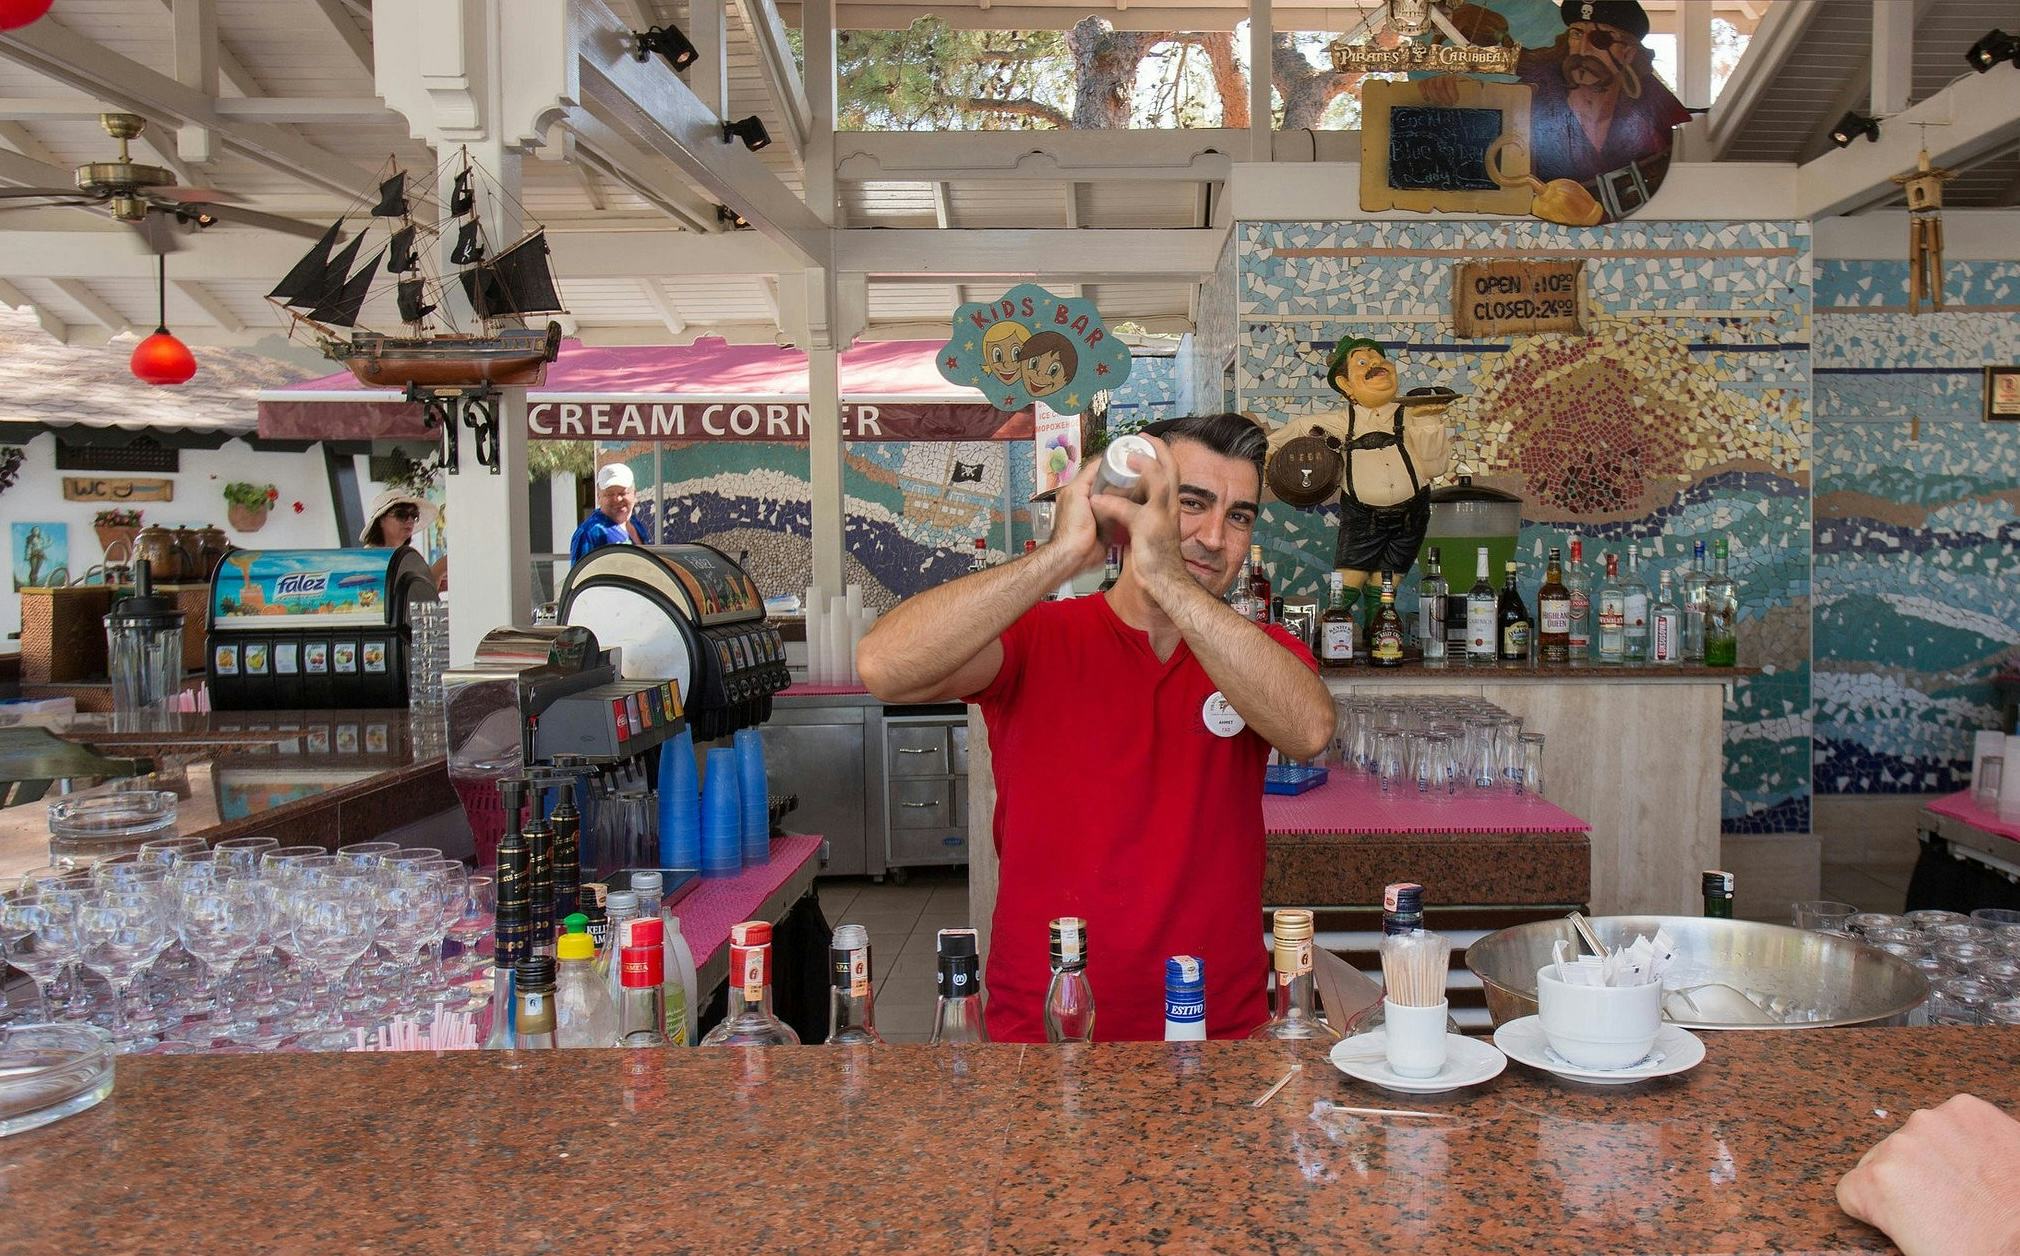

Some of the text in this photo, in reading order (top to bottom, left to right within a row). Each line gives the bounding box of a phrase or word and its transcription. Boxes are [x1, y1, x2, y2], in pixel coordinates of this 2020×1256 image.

[1336, 46, 1399, 65] PIRATES
[1440, 46, 1509, 65] CARIBBEAN
[1475, 275, 1521, 295] OPEN
[969, 296, 1104, 349] KIDS BAR
[528, 403, 686, 436] CREAM
[74, 480, 107, 497] WC
[278, 574, 326, 594] falez
[1171, 1003, 1204, 1016] ESTIVO
